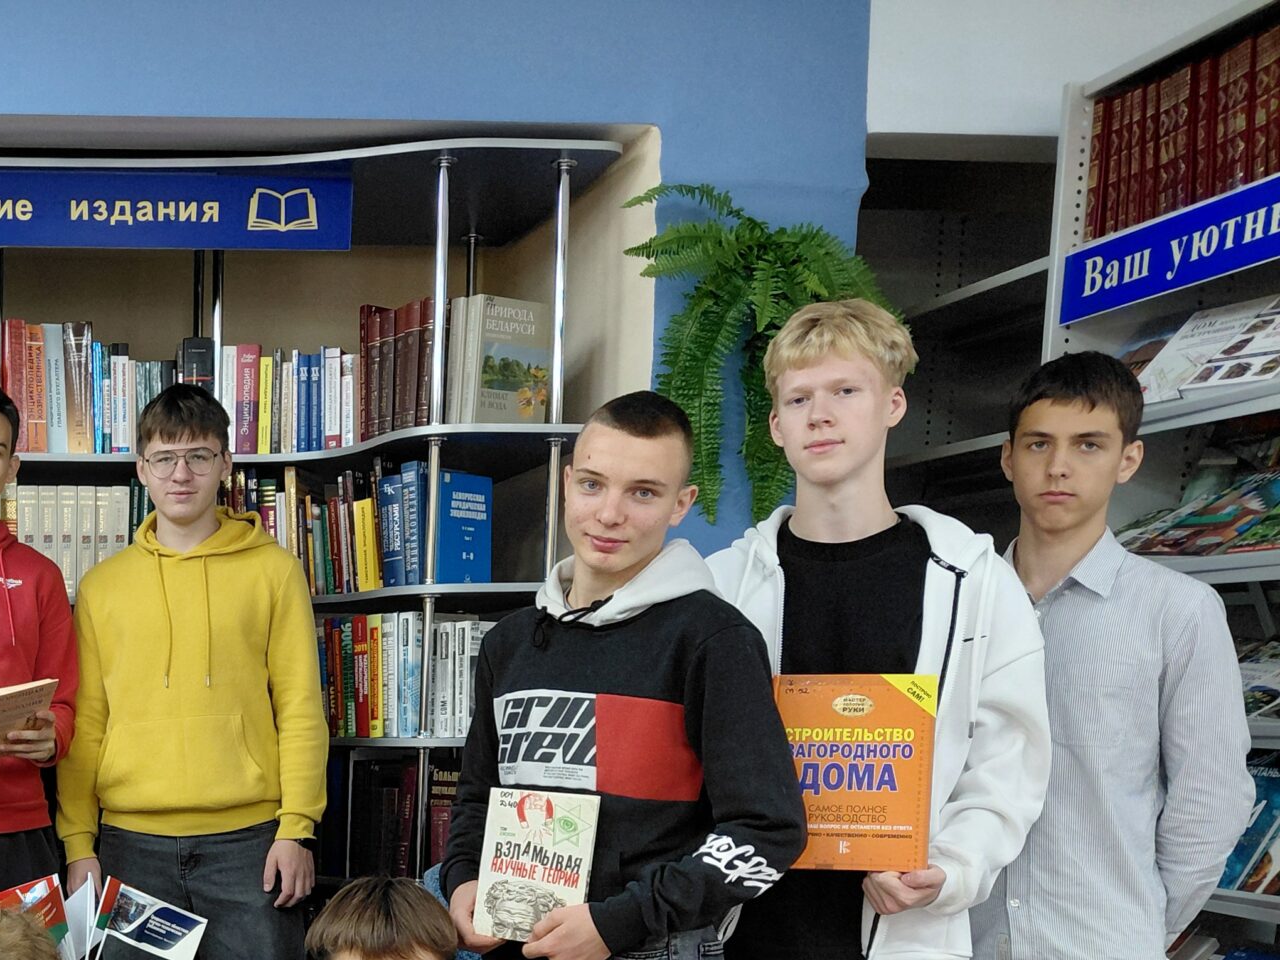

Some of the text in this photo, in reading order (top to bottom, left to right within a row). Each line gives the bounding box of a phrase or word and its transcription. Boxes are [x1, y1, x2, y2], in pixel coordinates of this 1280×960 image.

[70, 198, 222, 224] издания
[1081, 248, 1152, 298] Ваш
[485, 318, 535, 336] БЕЛАРУСИ
[486, 302, 534, 322] ПРИРОДА
[27, 345, 35, 419] ЭНЦИКЛОПЕДИЯ
[240, 368, 251, 436] Энциклопедия
[392, 503, 401, 551] РЕСУРСАМИ
[409, 486, 418, 569] ЭНЦИКЛОПЕДИЯ
[906, 688, 925, 703] САМ!
[786, 728, 914, 742] СТРОИТЕЛЬСТВО
[800, 762, 898, 796] ДОМА
[808, 804, 888, 814] САМОЕ ПОЛНОЕ
[808, 814, 887, 824] РУКОВОДСТВО
[490, 856, 580, 888] НАУЧНЫЕ ТЕОРИИ
[494, 840, 583, 874] ВЗЛАМЫВАЯ
